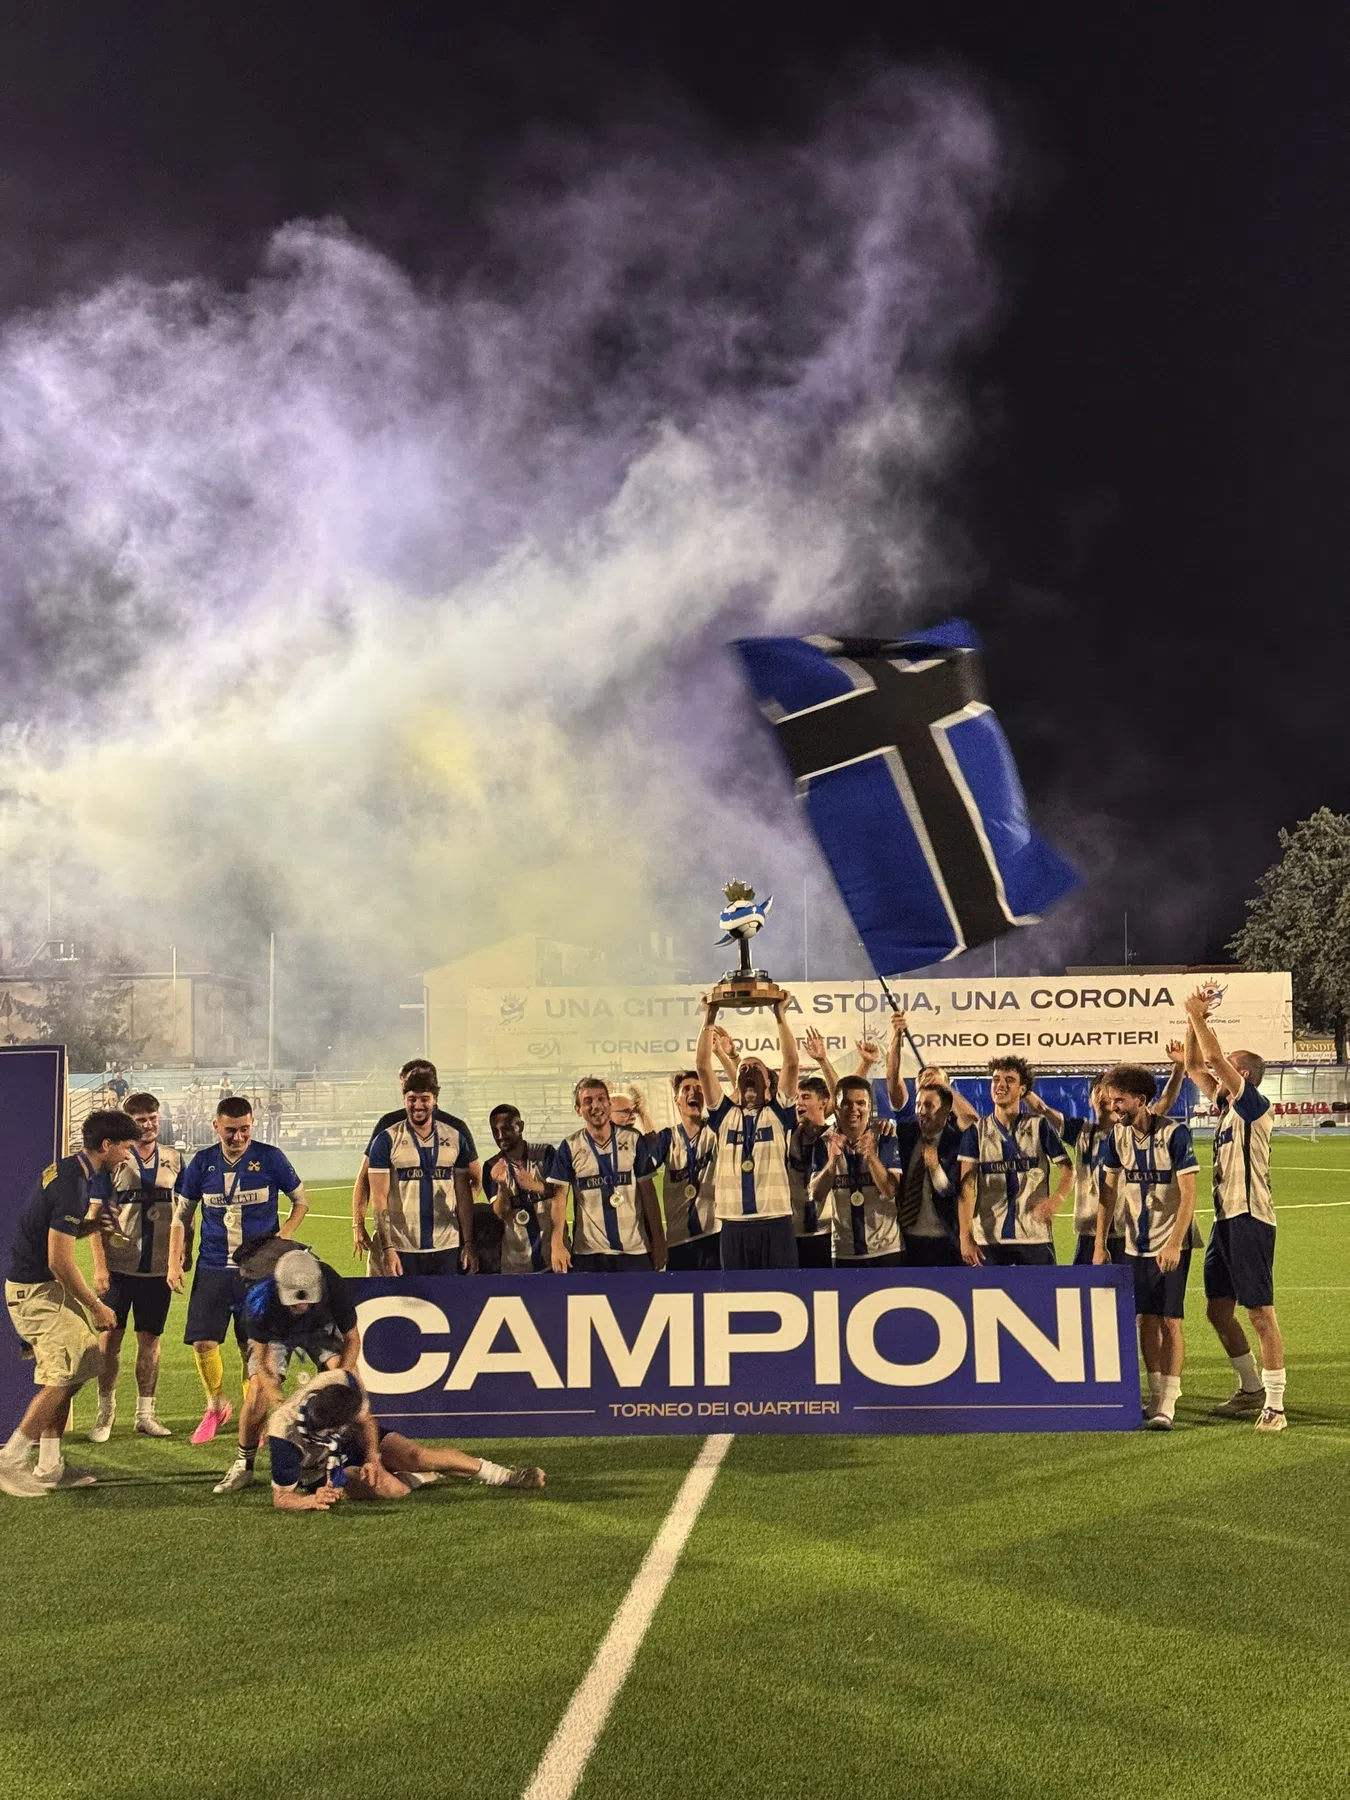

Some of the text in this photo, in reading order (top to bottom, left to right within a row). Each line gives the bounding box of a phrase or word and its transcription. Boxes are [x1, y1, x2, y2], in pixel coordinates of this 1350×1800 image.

[545, 998, 615, 1019] UNA
[951, 991, 1020, 1011] UNA
[1030, 987, 1175, 1009] CORONA
[586, 1038, 680, 1054] TORNEO
[996, 1033, 1031, 1046] DEI
[1037, 1030, 1159, 1048] QUARTIERI
[586, 1174, 627, 1188] CROCITI
[209, 1192, 258, 1206] CROIATI
[355, 1286, 1121, 1395] CAMPIONI
[608, 1401, 840, 1418] TORNEO DEI QUARTIERI
